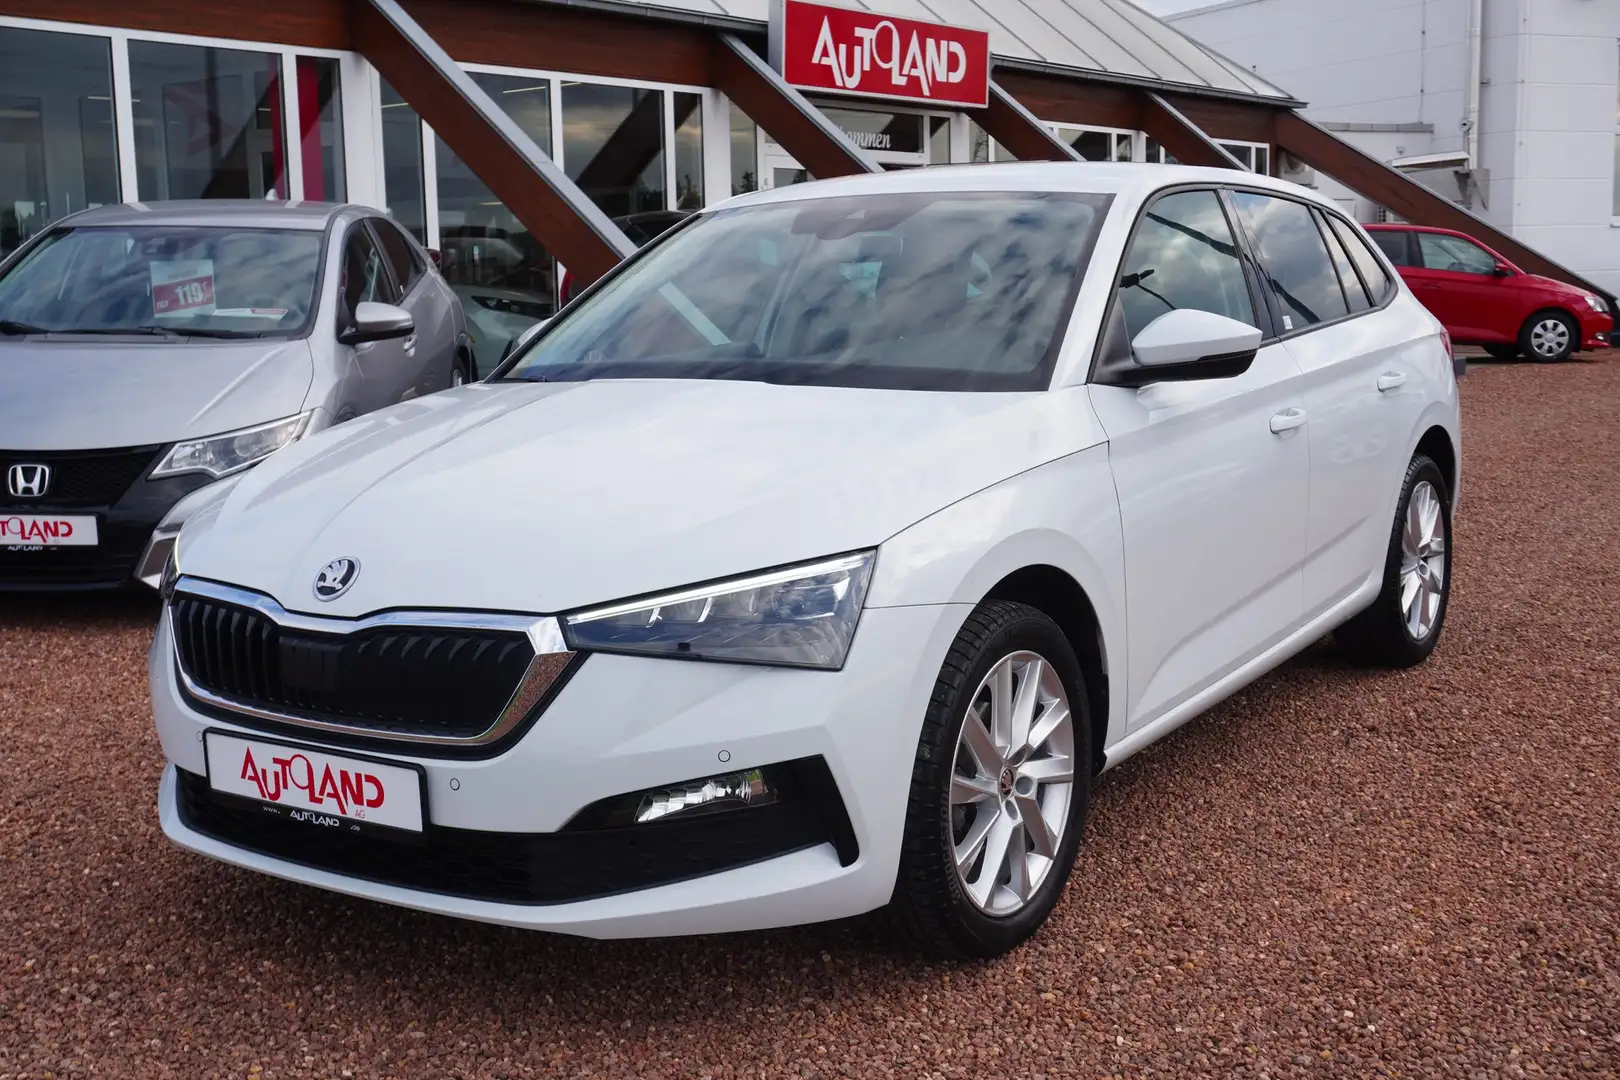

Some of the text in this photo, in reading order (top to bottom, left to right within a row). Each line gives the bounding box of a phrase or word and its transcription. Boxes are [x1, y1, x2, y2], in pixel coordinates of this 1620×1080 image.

[811, 15, 967, 97] AUTOLAND
[841, 126, 891, 149] ommen
[0, 516, 73, 544] TOLAND
[240, 746, 385, 816] AUTOLAND
[289, 809, 340, 827] AUTOLAND
[354, 807, 366, 820] AG
